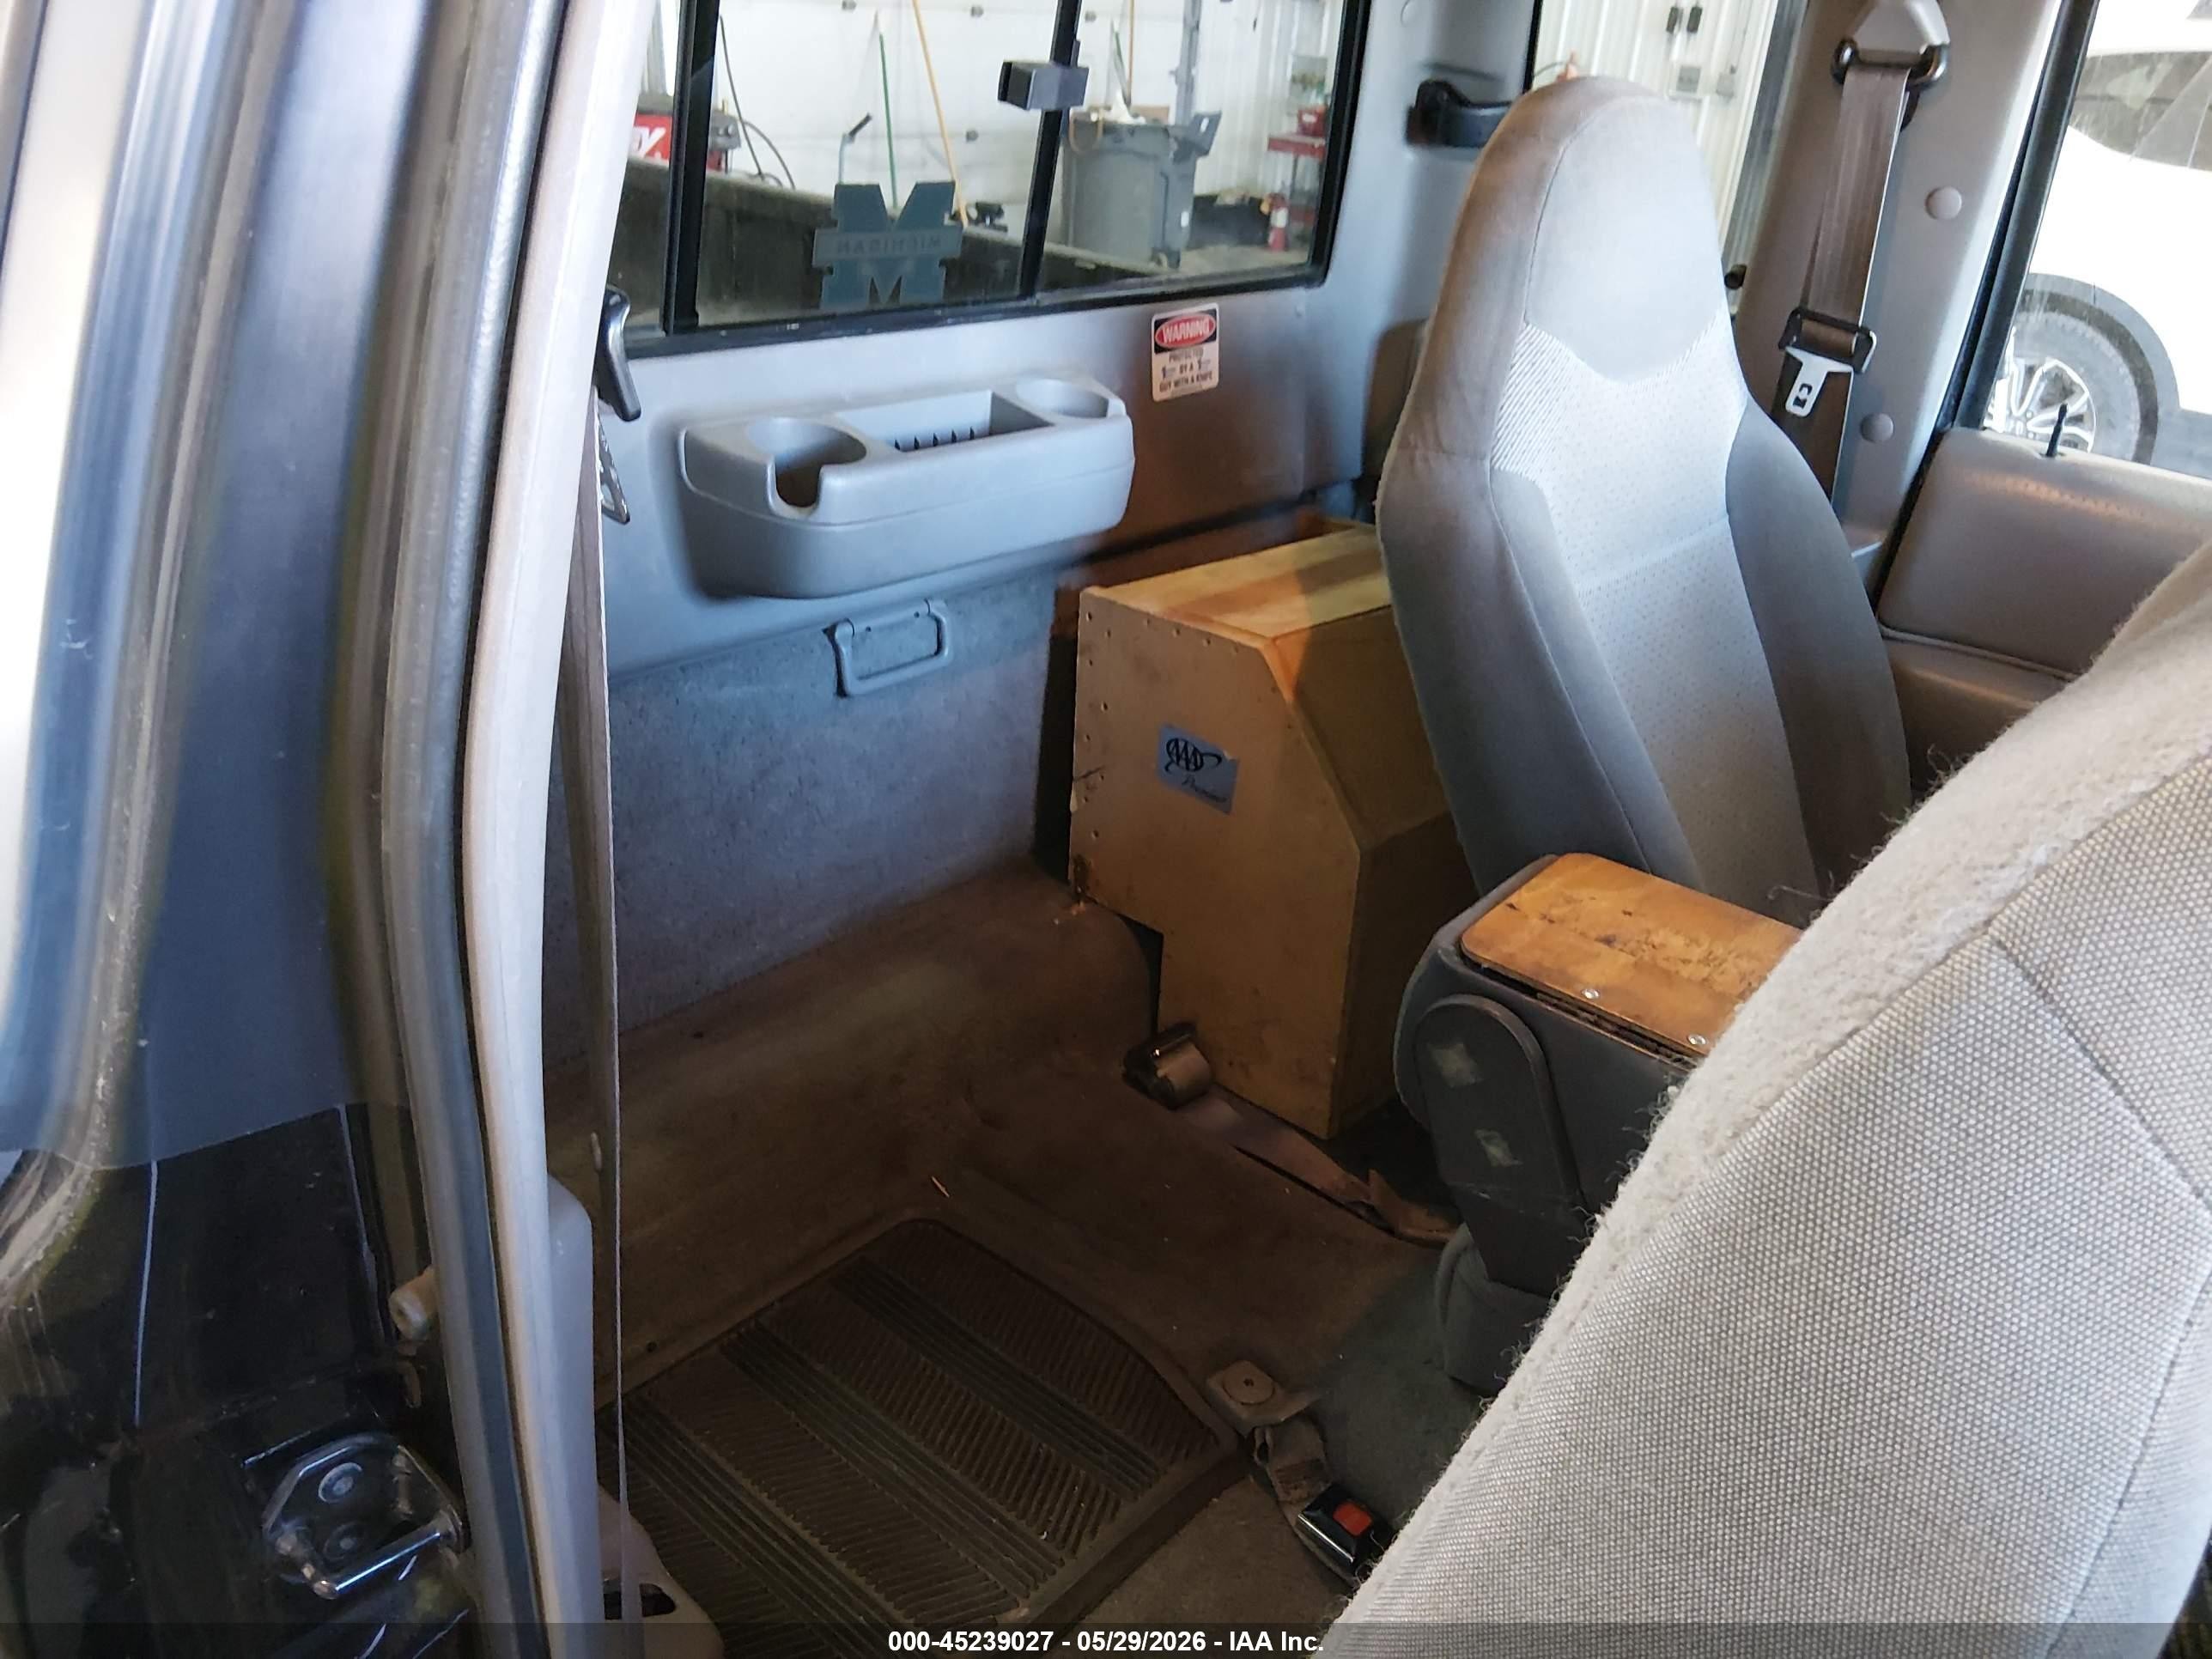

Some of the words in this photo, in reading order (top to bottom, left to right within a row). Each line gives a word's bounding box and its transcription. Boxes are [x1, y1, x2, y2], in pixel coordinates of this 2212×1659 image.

[1162, 315, 1210, 343] WARNING
[1159, 380, 1171, 392] GUY
[1173, 376, 1189, 388] WITH
[1196, 371, 1212, 383] KNIFE
